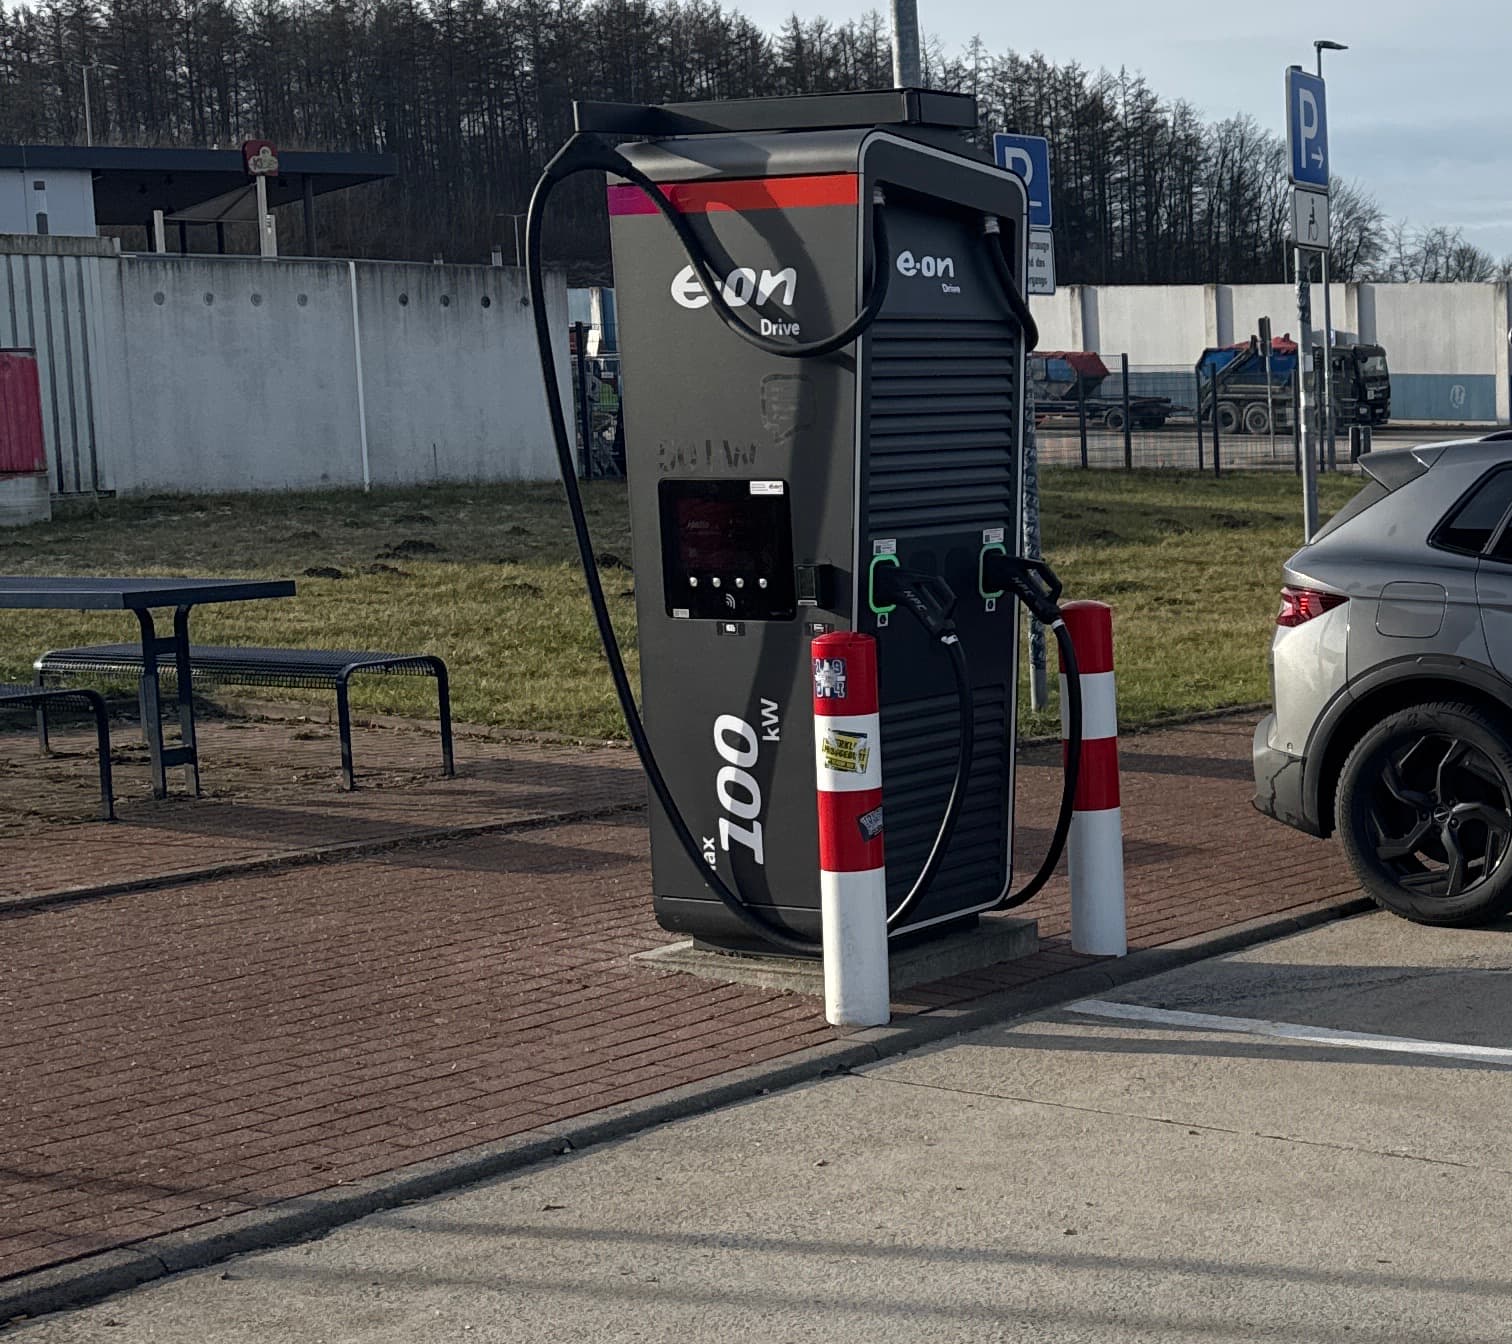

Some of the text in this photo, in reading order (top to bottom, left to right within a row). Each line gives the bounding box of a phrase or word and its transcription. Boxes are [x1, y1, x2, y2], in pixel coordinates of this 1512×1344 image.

[1299, 88, 1318, 168] P
[942, 283, 960, 293] Drive
[760, 319, 800, 336] Drive
[703, 698, 780, 884] ax 100 kW
